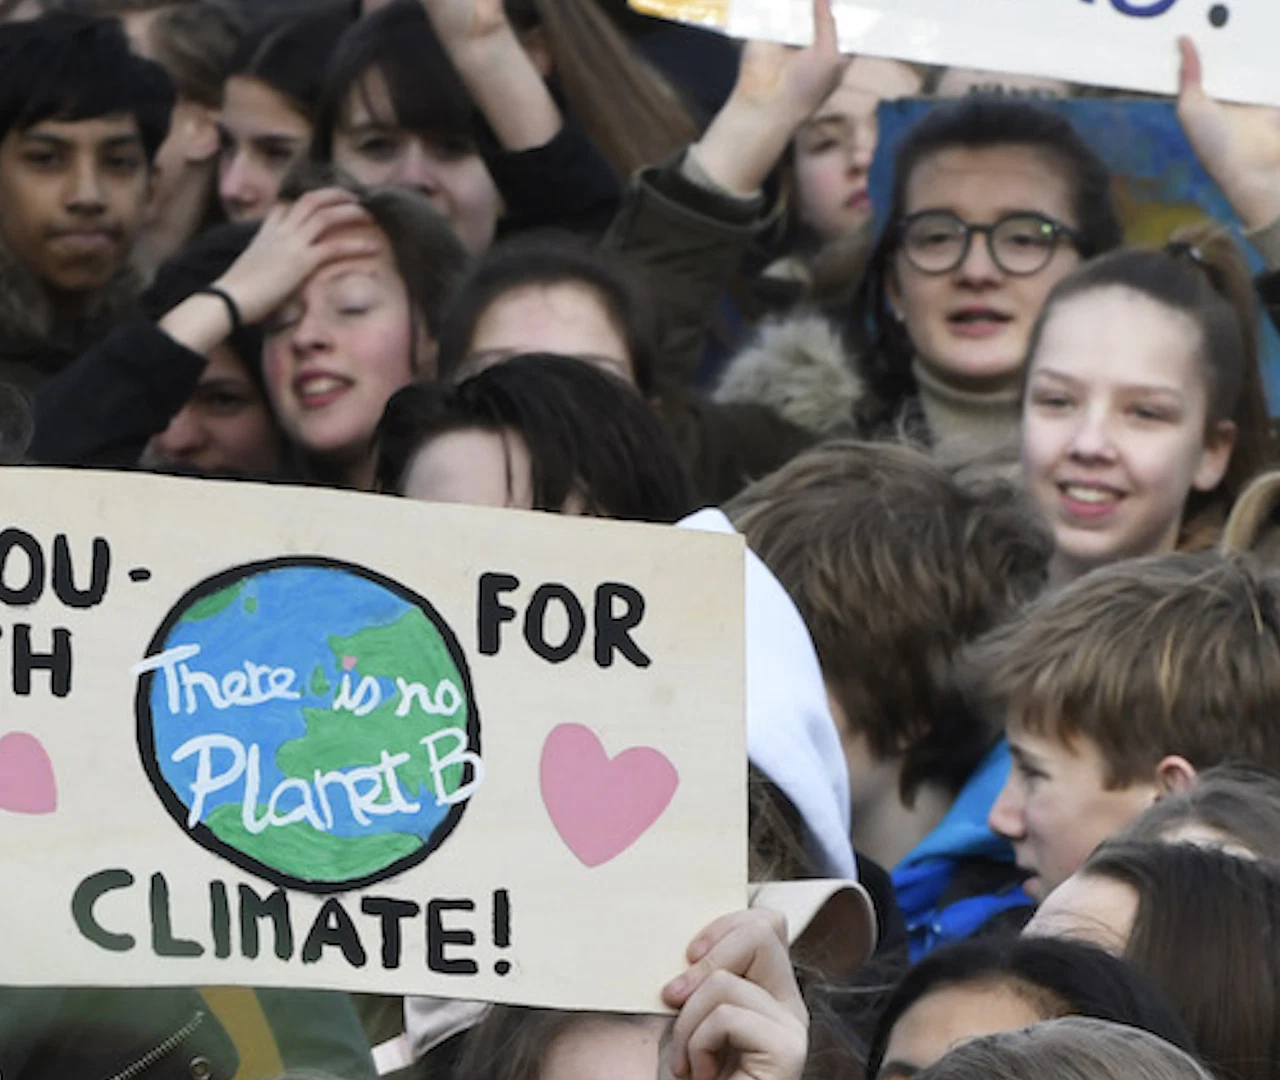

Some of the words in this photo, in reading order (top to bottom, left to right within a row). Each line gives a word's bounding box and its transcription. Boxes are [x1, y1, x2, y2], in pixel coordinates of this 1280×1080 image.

[477, 572, 651, 668] FOR
[130, 644, 301, 716] There
[332, 655, 381, 715] is
[395, 678, 460, 717] no
[171, 734, 420, 834] Planet
[418, 728, 485, 808] B
[71, 868, 512, 976] CLIMATE!
